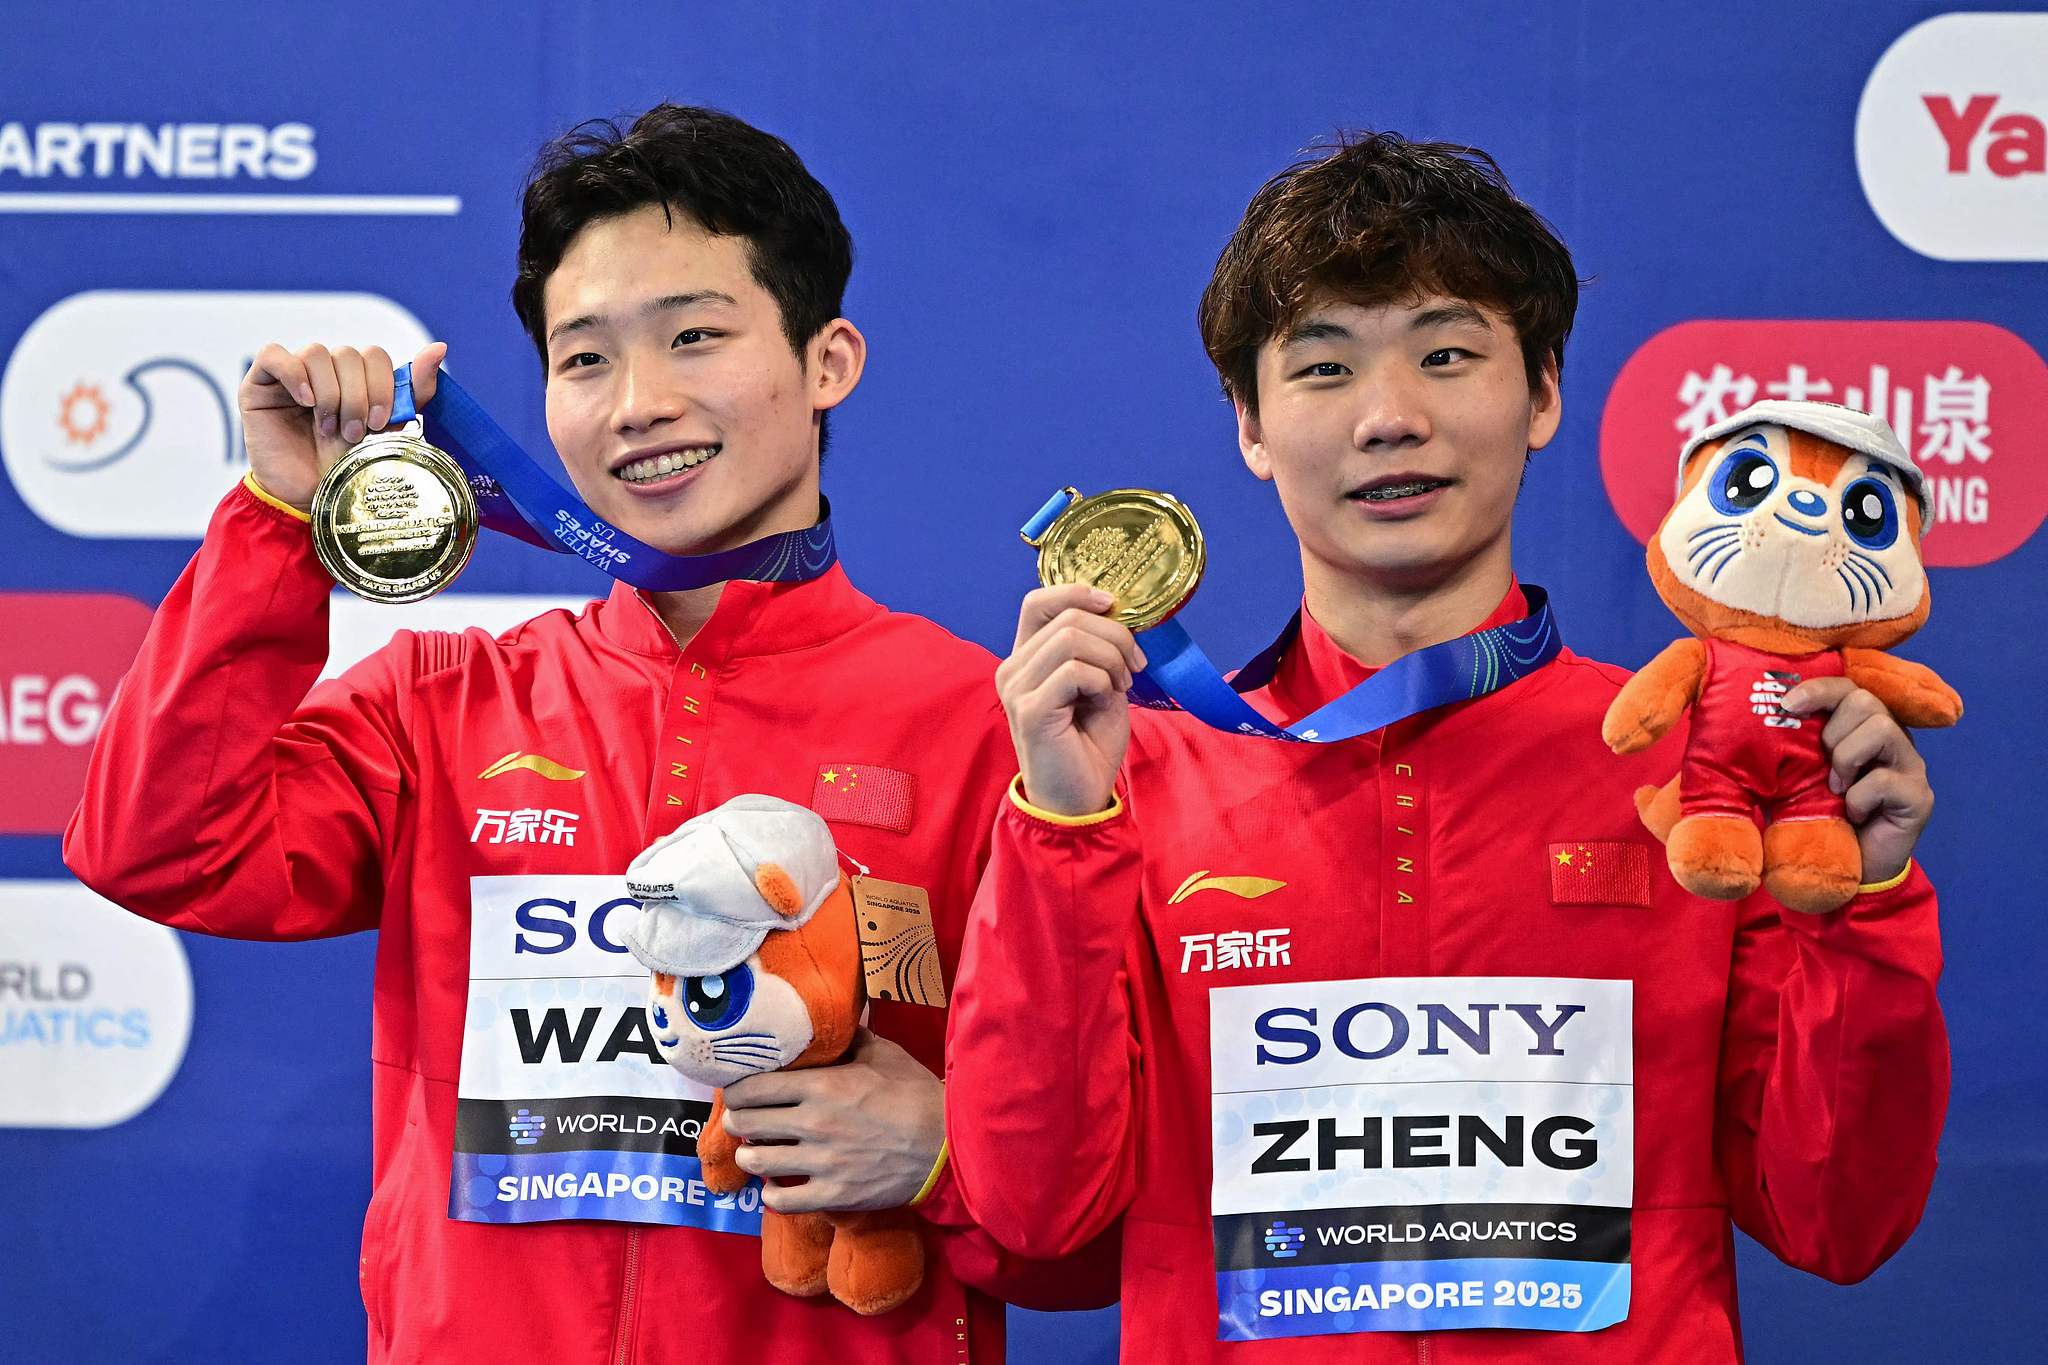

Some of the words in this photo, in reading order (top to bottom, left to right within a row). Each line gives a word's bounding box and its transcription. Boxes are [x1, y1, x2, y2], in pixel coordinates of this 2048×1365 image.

[0, 122, 317, 180] ARTNERS
[554, 522, 611, 572] WATER
[555, 509, 631, 564] SHAPES
[591, 522, 615, 541] US
[0, 674, 101, 745] EG
[666, 663, 706, 807] CHINA
[470, 807, 580, 847] 万家乐
[1396, 763, 1414, 904] CHINA
[866, 900, 904, 912] SINGAPORE
[905, 907, 921, 915] 2025
[1179, 927, 1292, 974] 万家乐
[1254, 1002, 1586, 1066] SONY
[557, 1113, 657, 1135] WORLD
[1251, 1115, 1599, 1175] ZHENG
[496, 1171, 706, 1206] SINGAPORE
[1316, 1223, 1426, 1247] WORLD
[1428, 1221, 1578, 1245] AQUATICS
[1259, 1281, 1484, 1318] SINGAPORE
[1493, 1279, 1583, 1310] 2025
[955, 1318, 966, 1365] CHI
